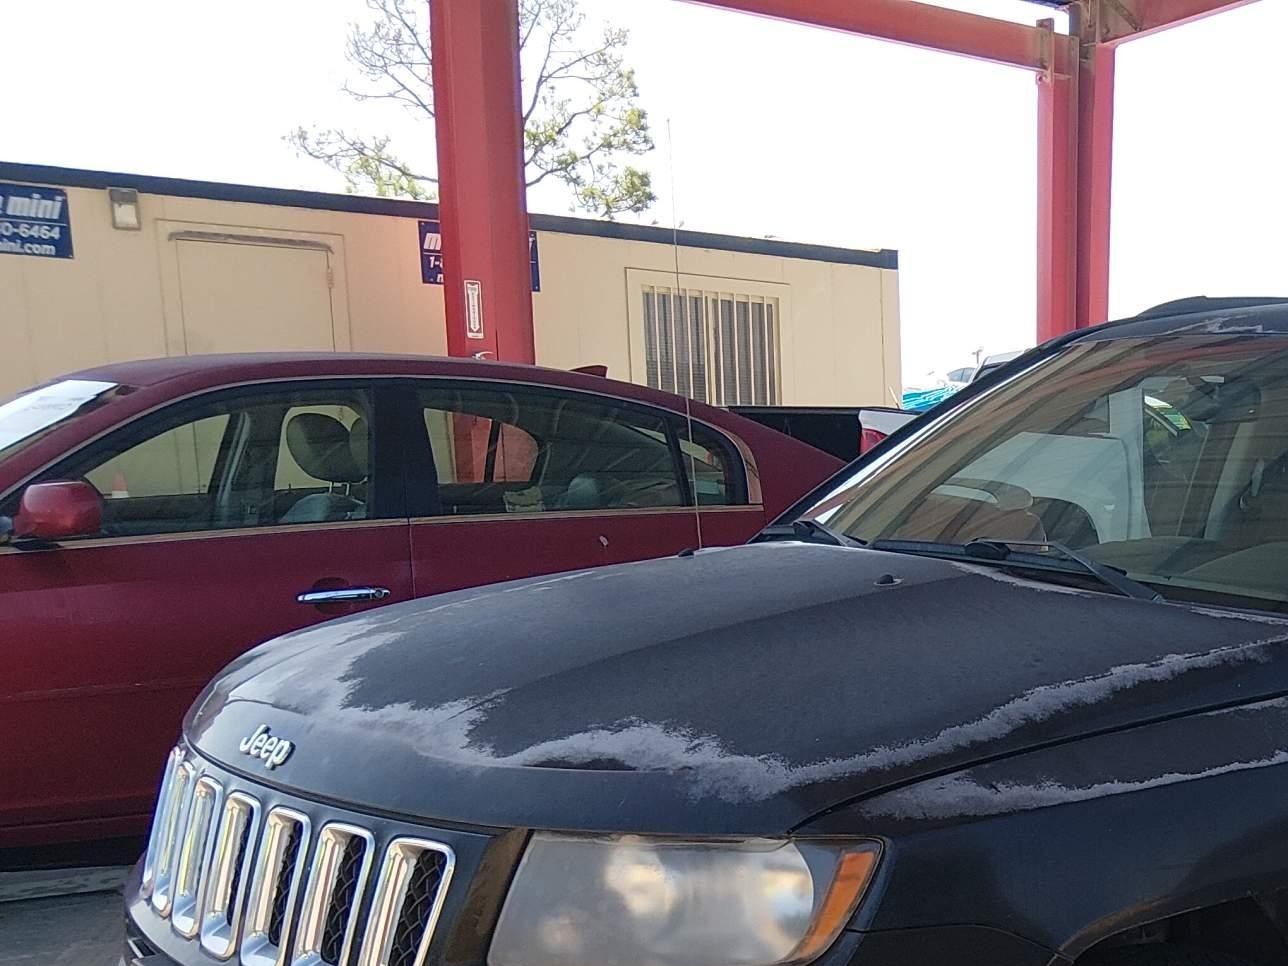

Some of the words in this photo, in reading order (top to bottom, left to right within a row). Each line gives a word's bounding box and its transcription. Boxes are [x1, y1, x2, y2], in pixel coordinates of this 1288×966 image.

[6, 193, 64, 219] mini
[0, 222, 61, 240] 0-6464
[0, 238, 56, 255] ini.com
[239, 724, 293, 769] Jeep
